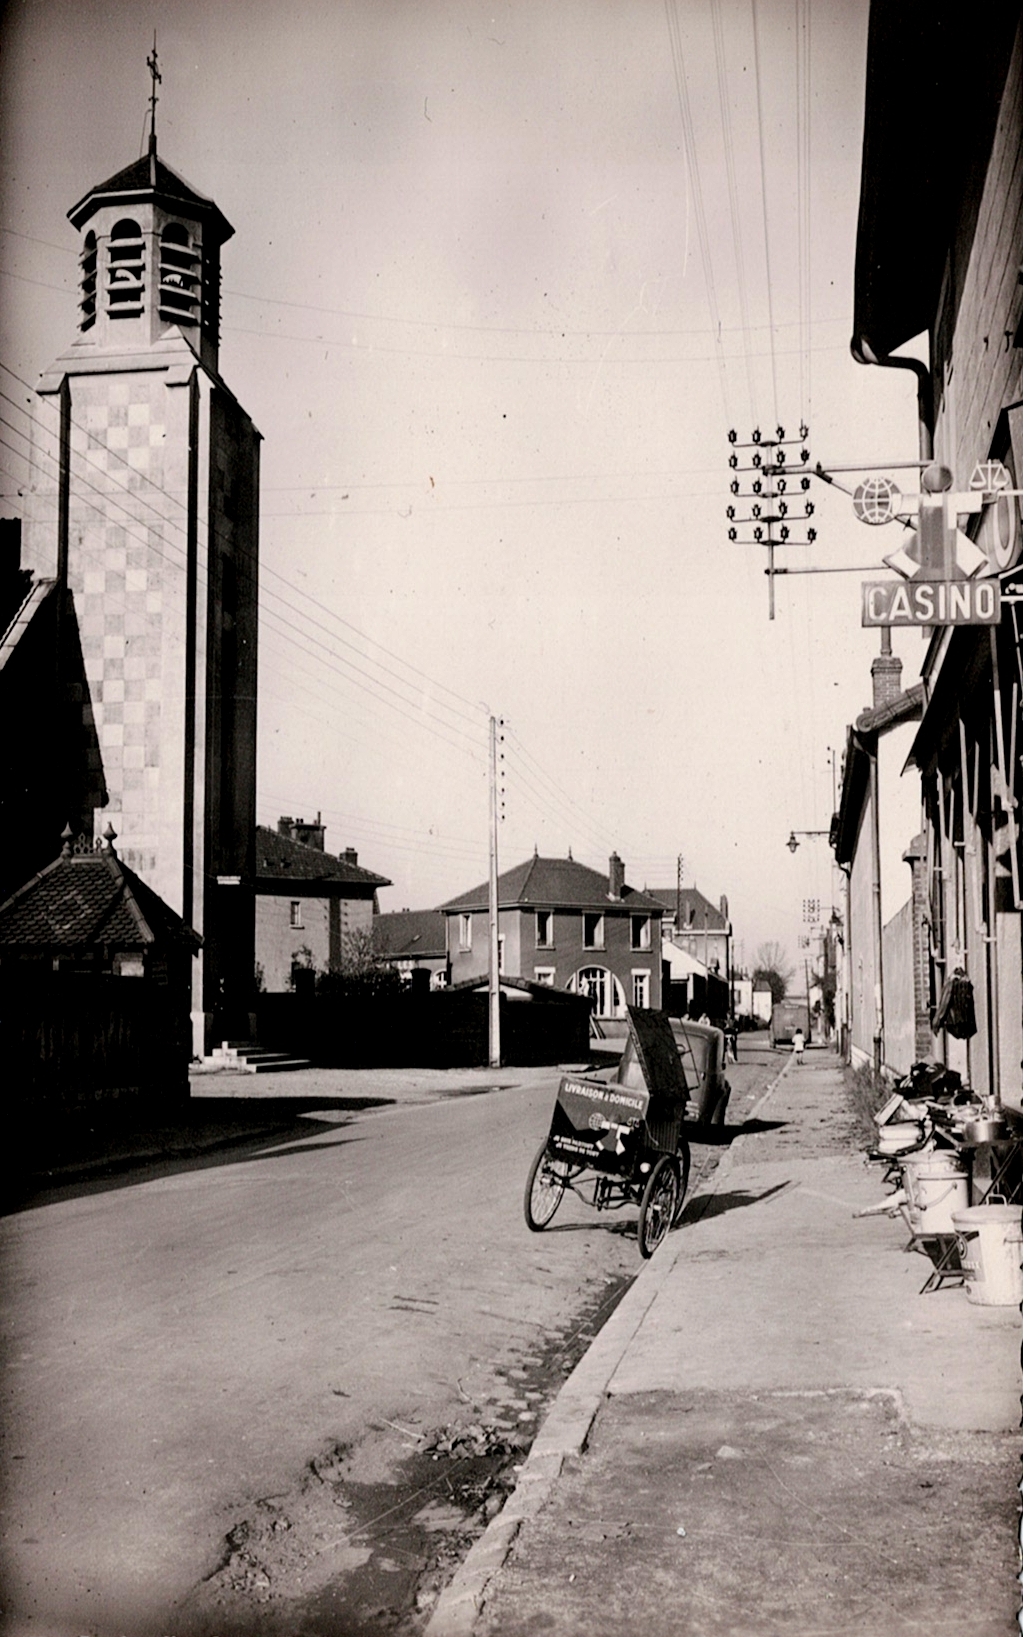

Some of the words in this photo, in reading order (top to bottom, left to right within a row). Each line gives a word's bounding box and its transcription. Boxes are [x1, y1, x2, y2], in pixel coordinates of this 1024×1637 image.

[868, 584, 994, 620] CASINO
[565, 1083, 604, 1100] LIVRAISON
[610, 1093, 643, 1110] DOMICILE
